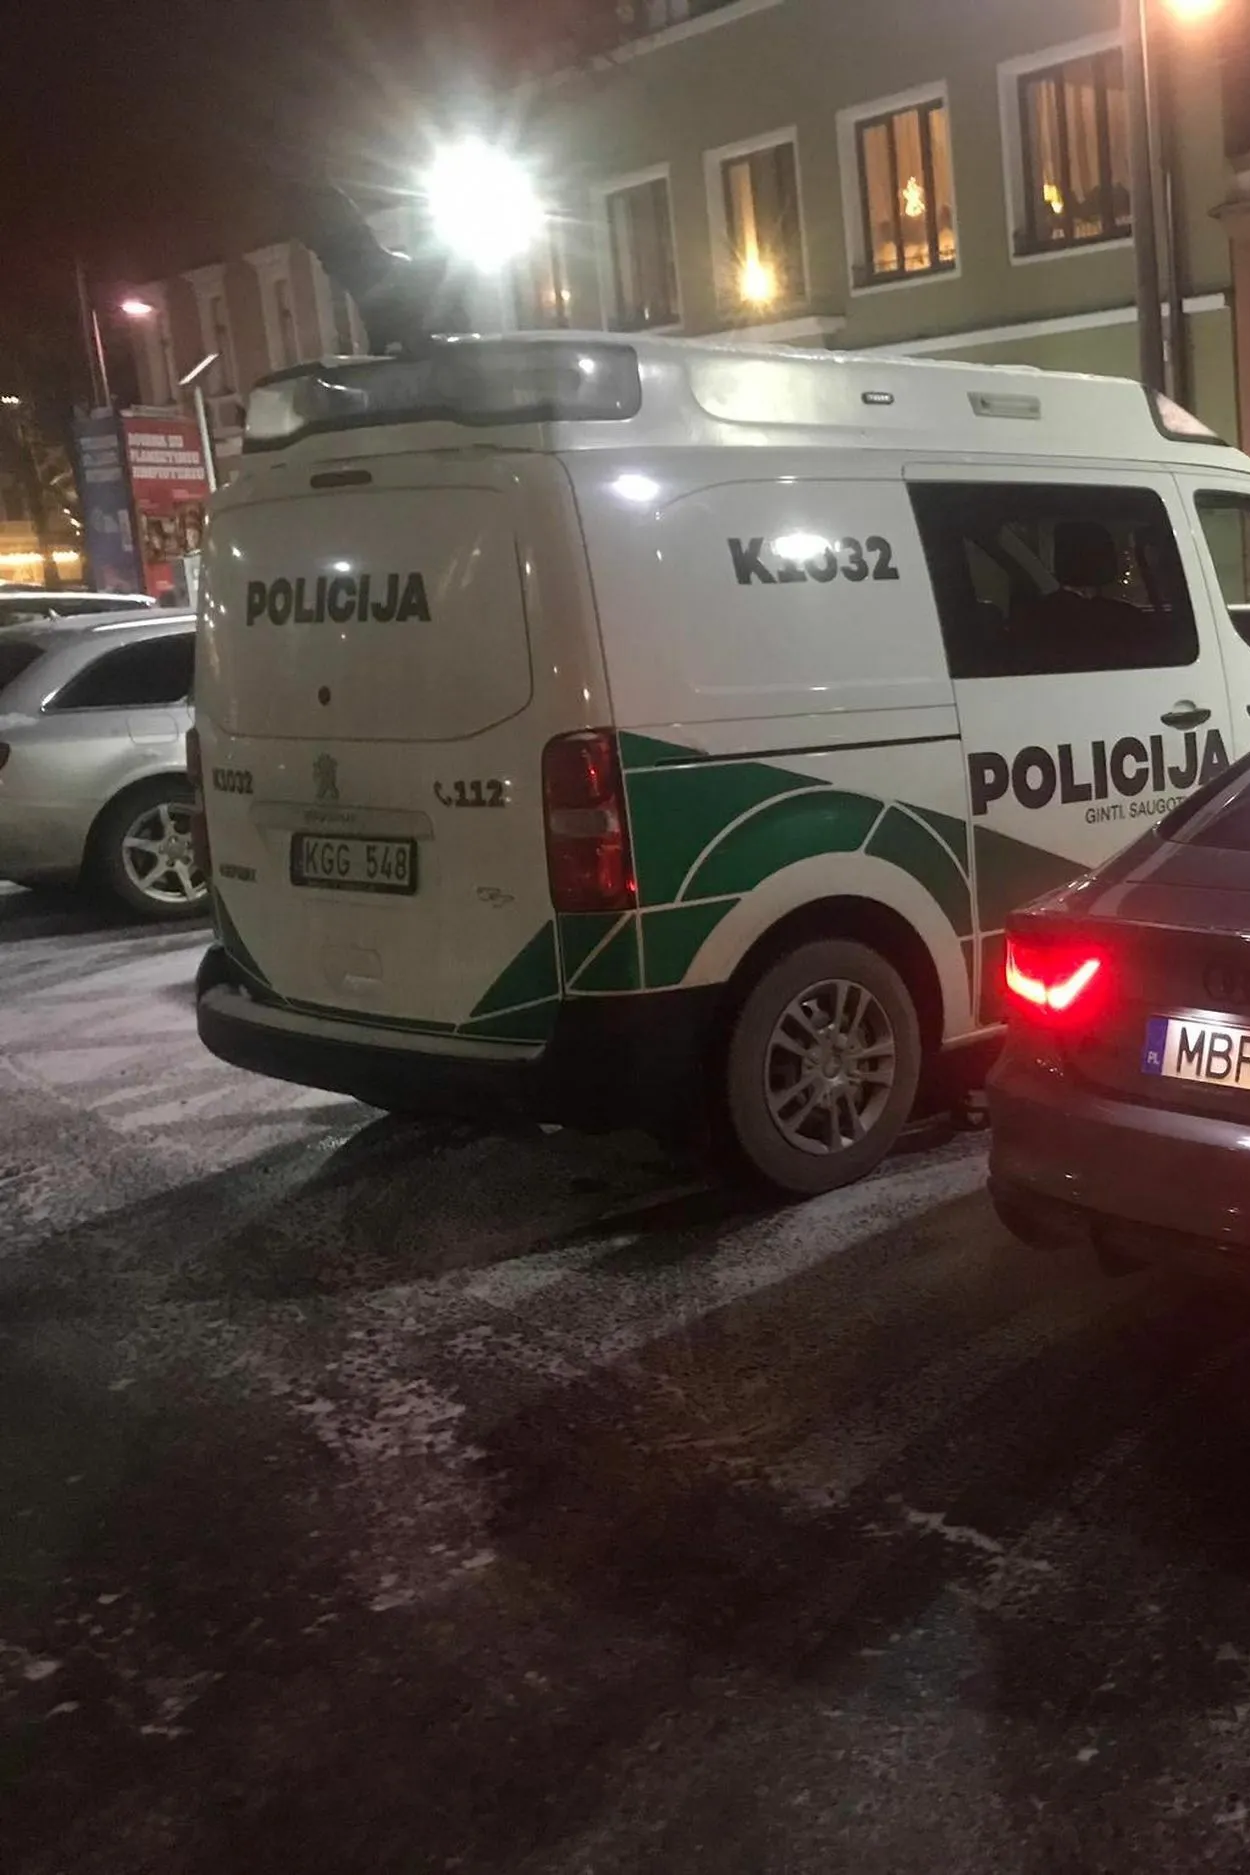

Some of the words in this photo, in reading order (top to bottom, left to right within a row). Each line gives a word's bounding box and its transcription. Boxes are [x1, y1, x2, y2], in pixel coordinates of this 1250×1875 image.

[246, 572, 432, 627] POLICIJA
[454, 780, 505, 808] 112
[968, 729, 1230, 816] POLICIJA
[305, 840, 351, 877] KGG
[366, 844, 408, 881] 548
